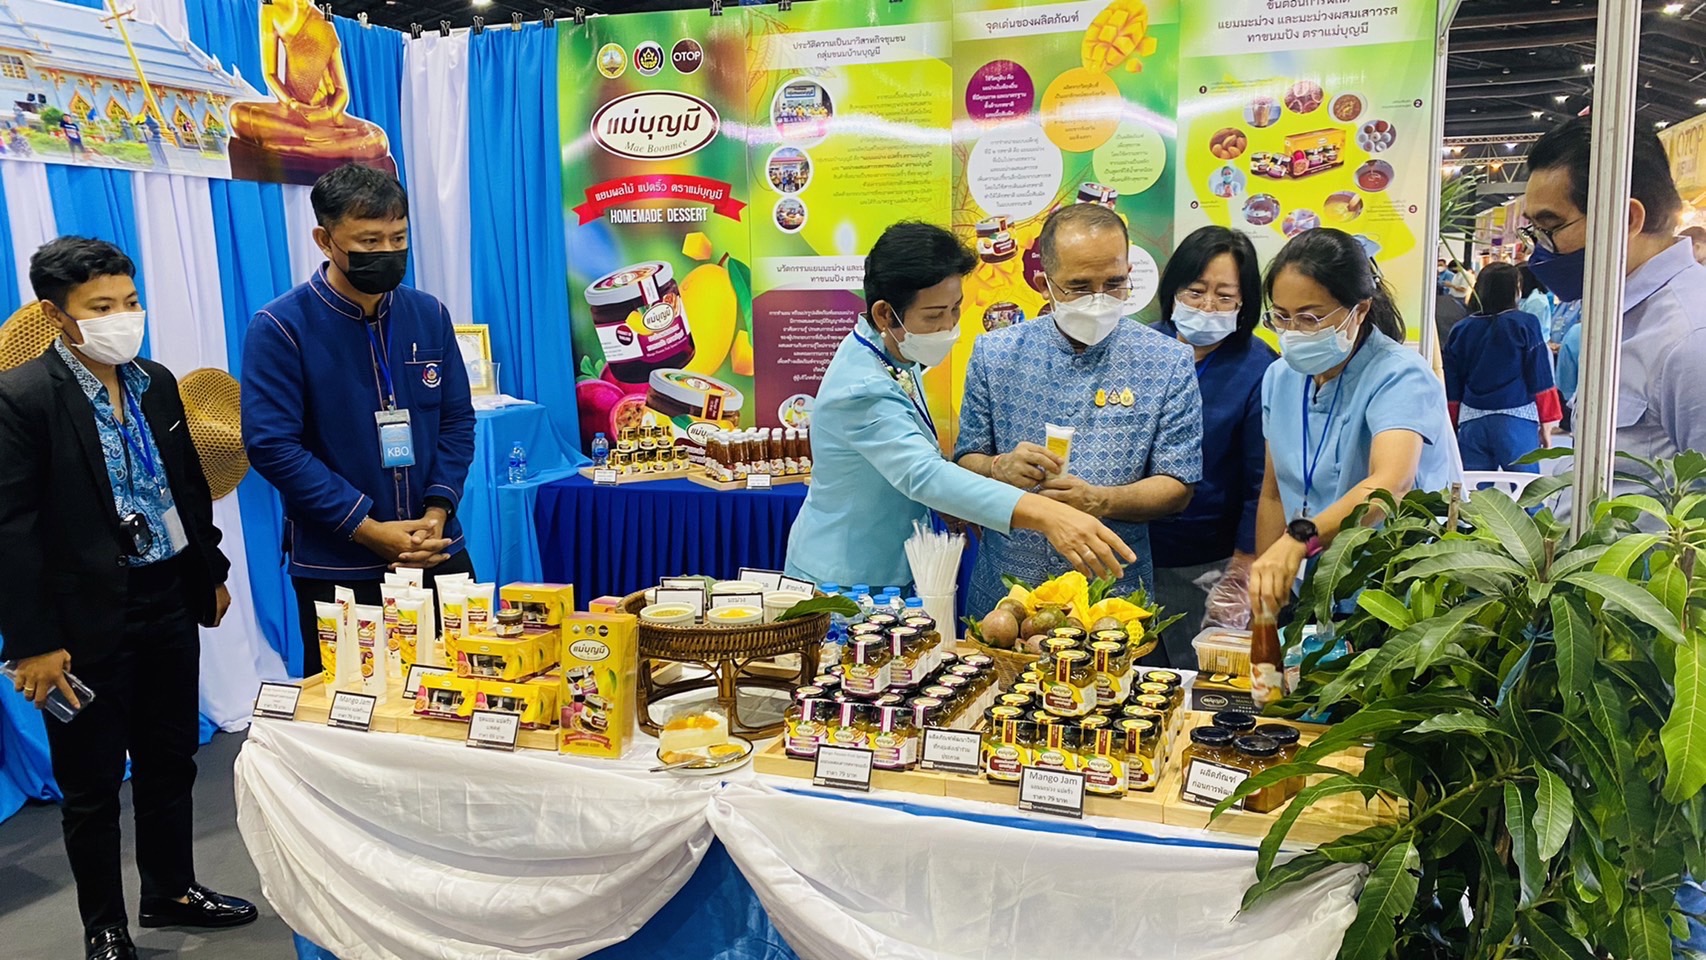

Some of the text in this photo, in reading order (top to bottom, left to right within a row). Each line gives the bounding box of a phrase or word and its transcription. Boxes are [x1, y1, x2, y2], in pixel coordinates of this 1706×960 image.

[985, 11, 1080, 36] จุดเด่นของผลิตภัณฑ์
[1217, 6, 1398, 31] แยมมะม่วง และมะม่วงผสมเสาวรส
[1247, 21, 1369, 43] ทาขนมปัง ตราแม่บุญมี
[673, 51, 701, 62] OTOP
[607, 106, 701, 140] แม่บุญมี
[624, 139, 688, 153] Mae Boonmee
[595, 178, 723, 202] แยมผลไม้ แปดริ้ว ตราแม่บุญมี
[610, 207, 708, 224] HOMEMADE DESSERT
[810, 274, 844, 283] ทาขนมปัง
[387, 446, 409, 457] KBO
[573, 643, 605, 655] แม่บุญมี
[339, 695, 372, 706] Mango Jam
[1029, 772, 1078, 786] Mango Jam
[1199, 768, 1237, 784] ผลิตภัณฑ์
